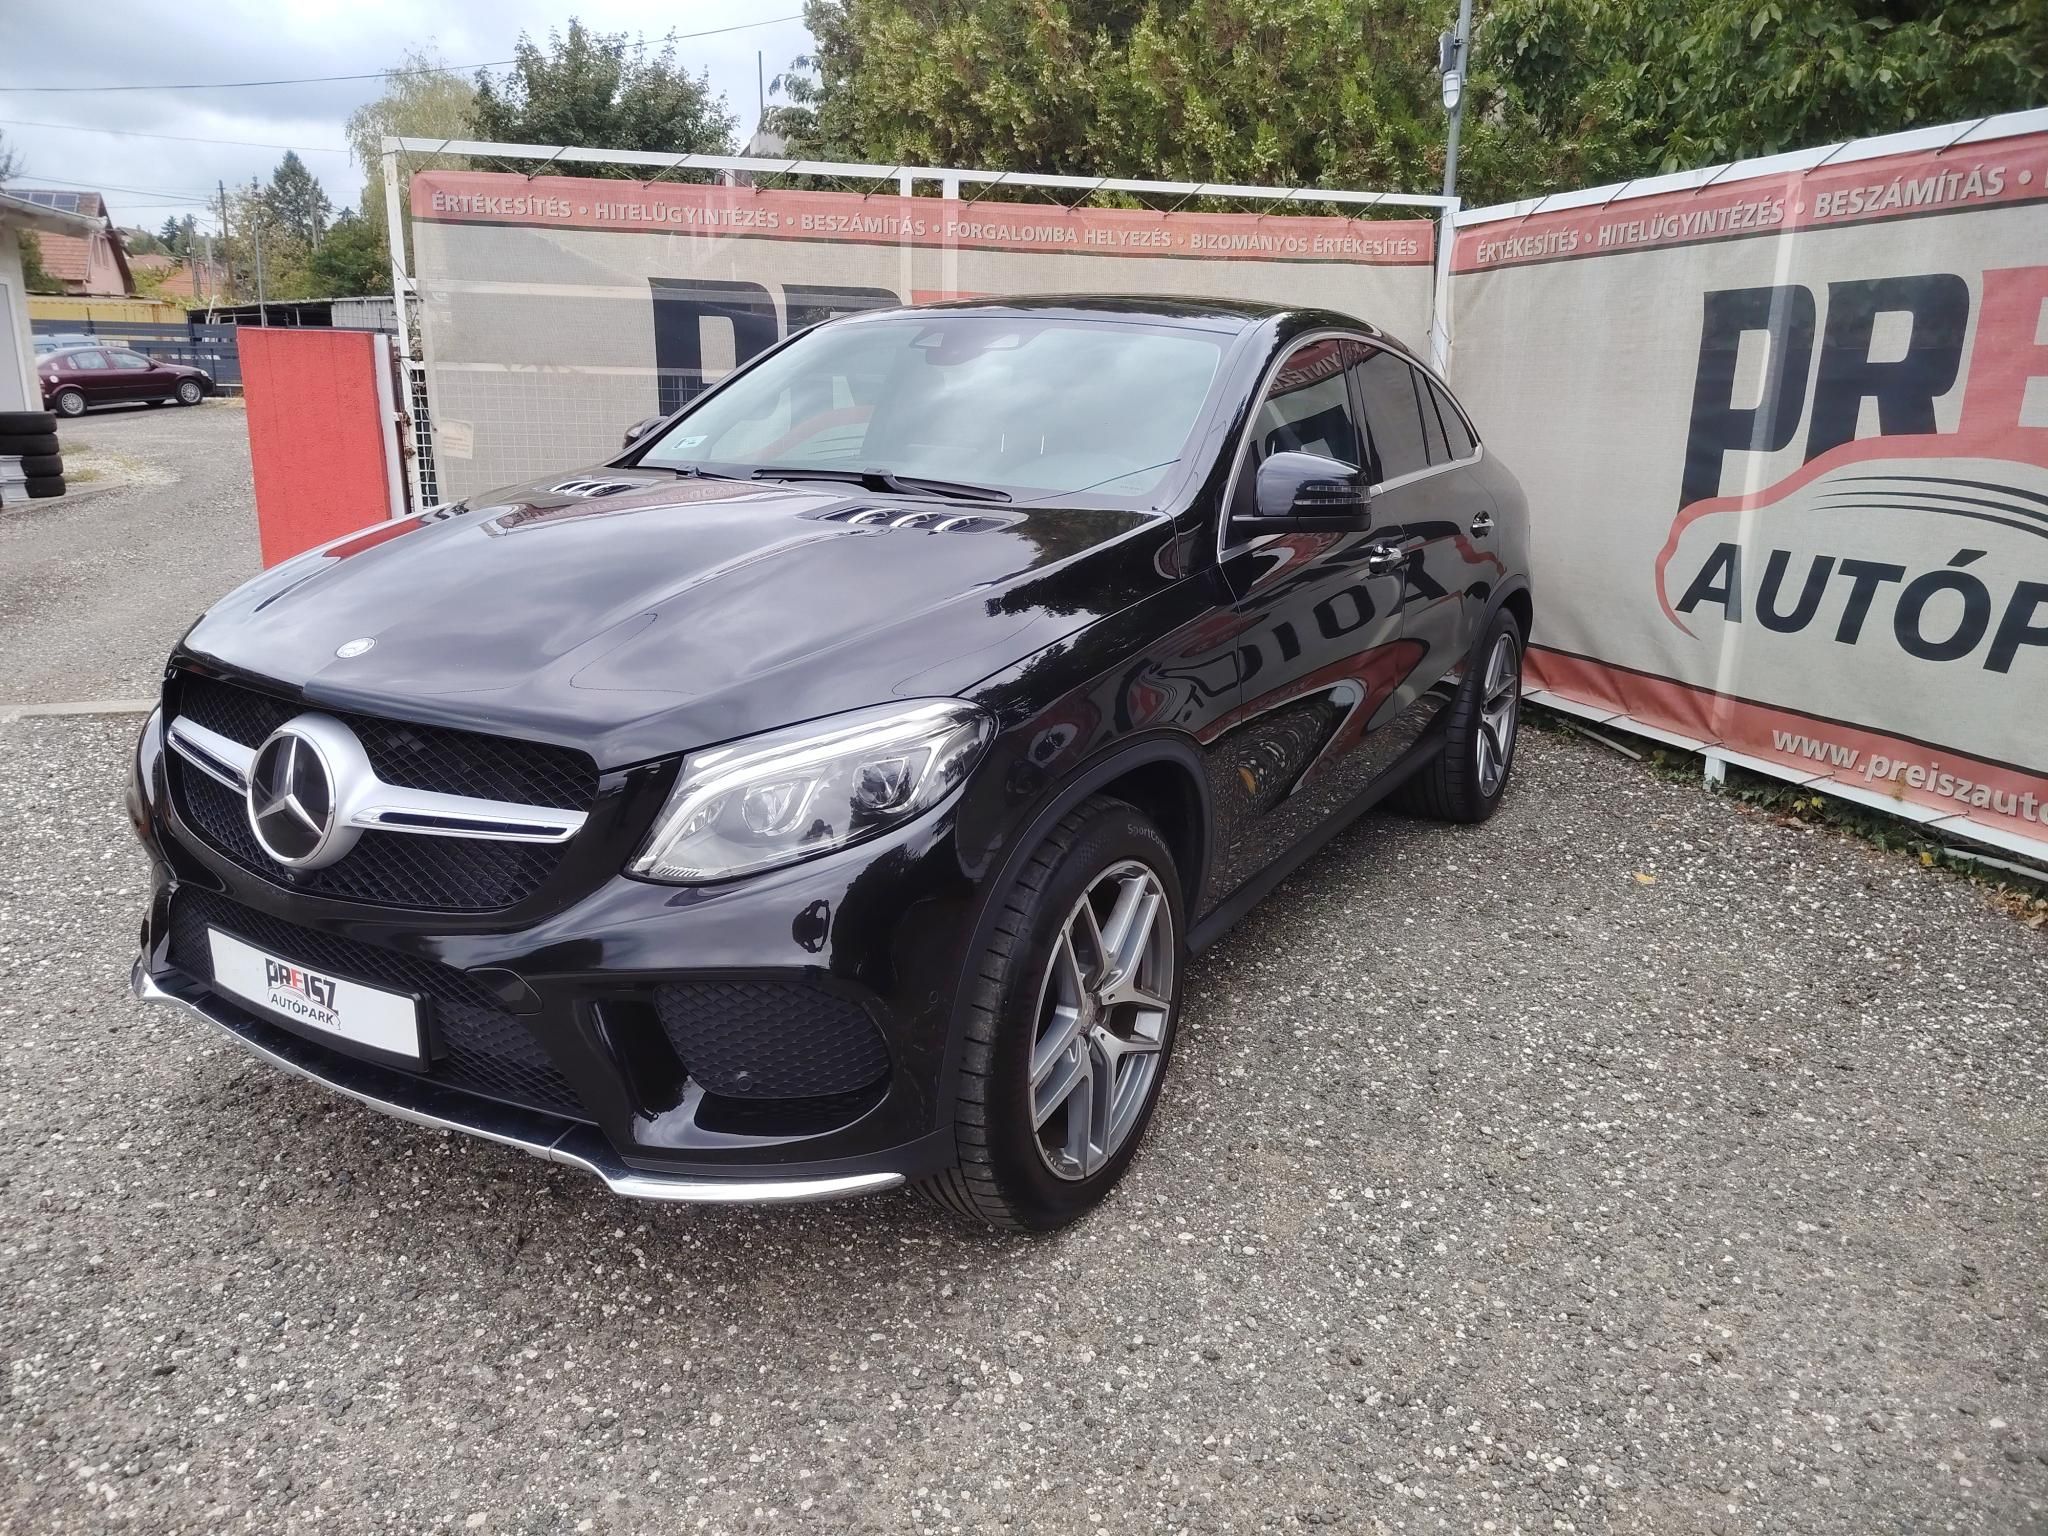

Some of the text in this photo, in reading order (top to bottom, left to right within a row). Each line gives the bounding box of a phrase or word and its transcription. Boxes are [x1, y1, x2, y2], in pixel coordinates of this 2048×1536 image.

[431, 190, 1418, 256] ÉRTÉKESÍTÉS HITELÜGYINTÉZÉS BESZÁMÍTÁS FORGALOMBA HELYEZÉS BIZOMÁNYOS ÉRTÉKESÍTÉS
[1476, 228, 1579, 263] ÉRTÉKESÍTÉS
[1598, 199, 1784, 246] HITELÜGYINTÉZÉS
[1814, 166, 2007, 219] BESZÁMÍTÁS
[265, 958, 339, 1016] PREISZ
[270, 993, 335, 1026] AUTÓPARK
